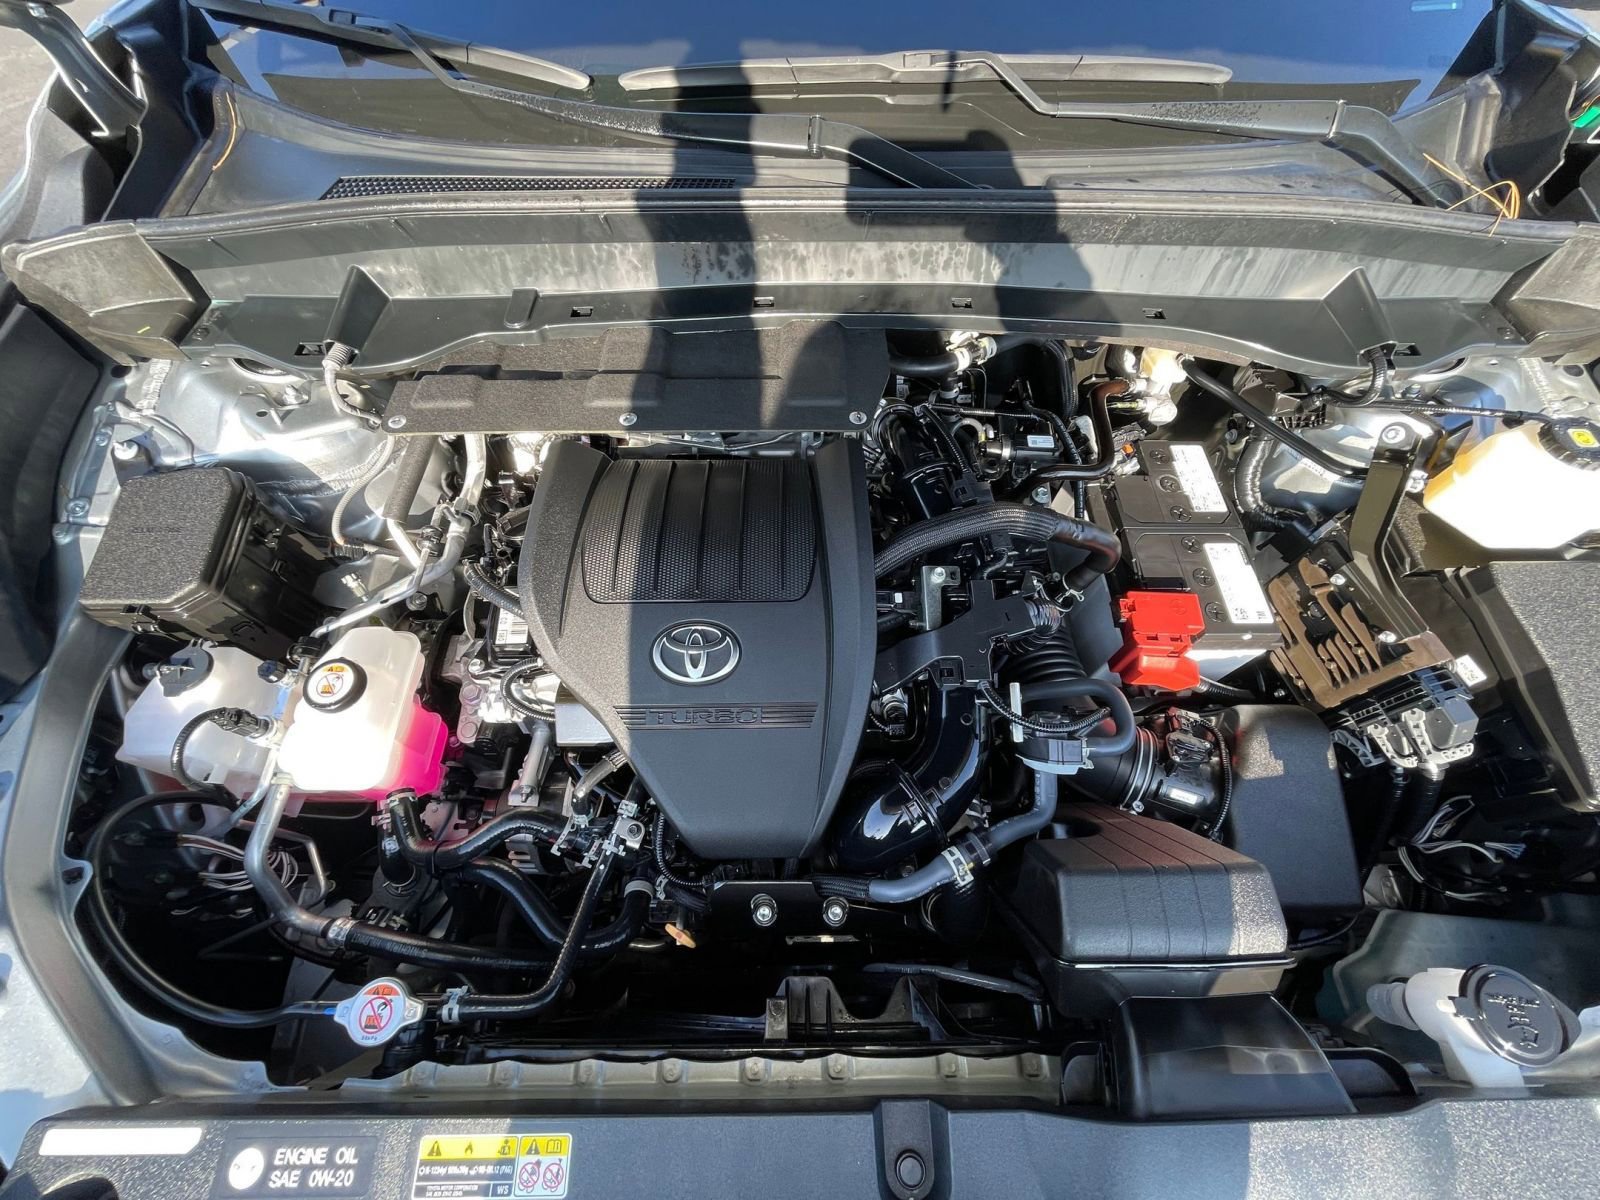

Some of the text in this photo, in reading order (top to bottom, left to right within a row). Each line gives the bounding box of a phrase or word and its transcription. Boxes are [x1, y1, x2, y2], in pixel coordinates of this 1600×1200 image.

[650, 708, 758, 725] TURBO
[274, 1147, 358, 1165] ENGINE OIL
[268, 1168, 354, 1188] SAE 0W-20
[497, 1185, 509, 1194] WS
